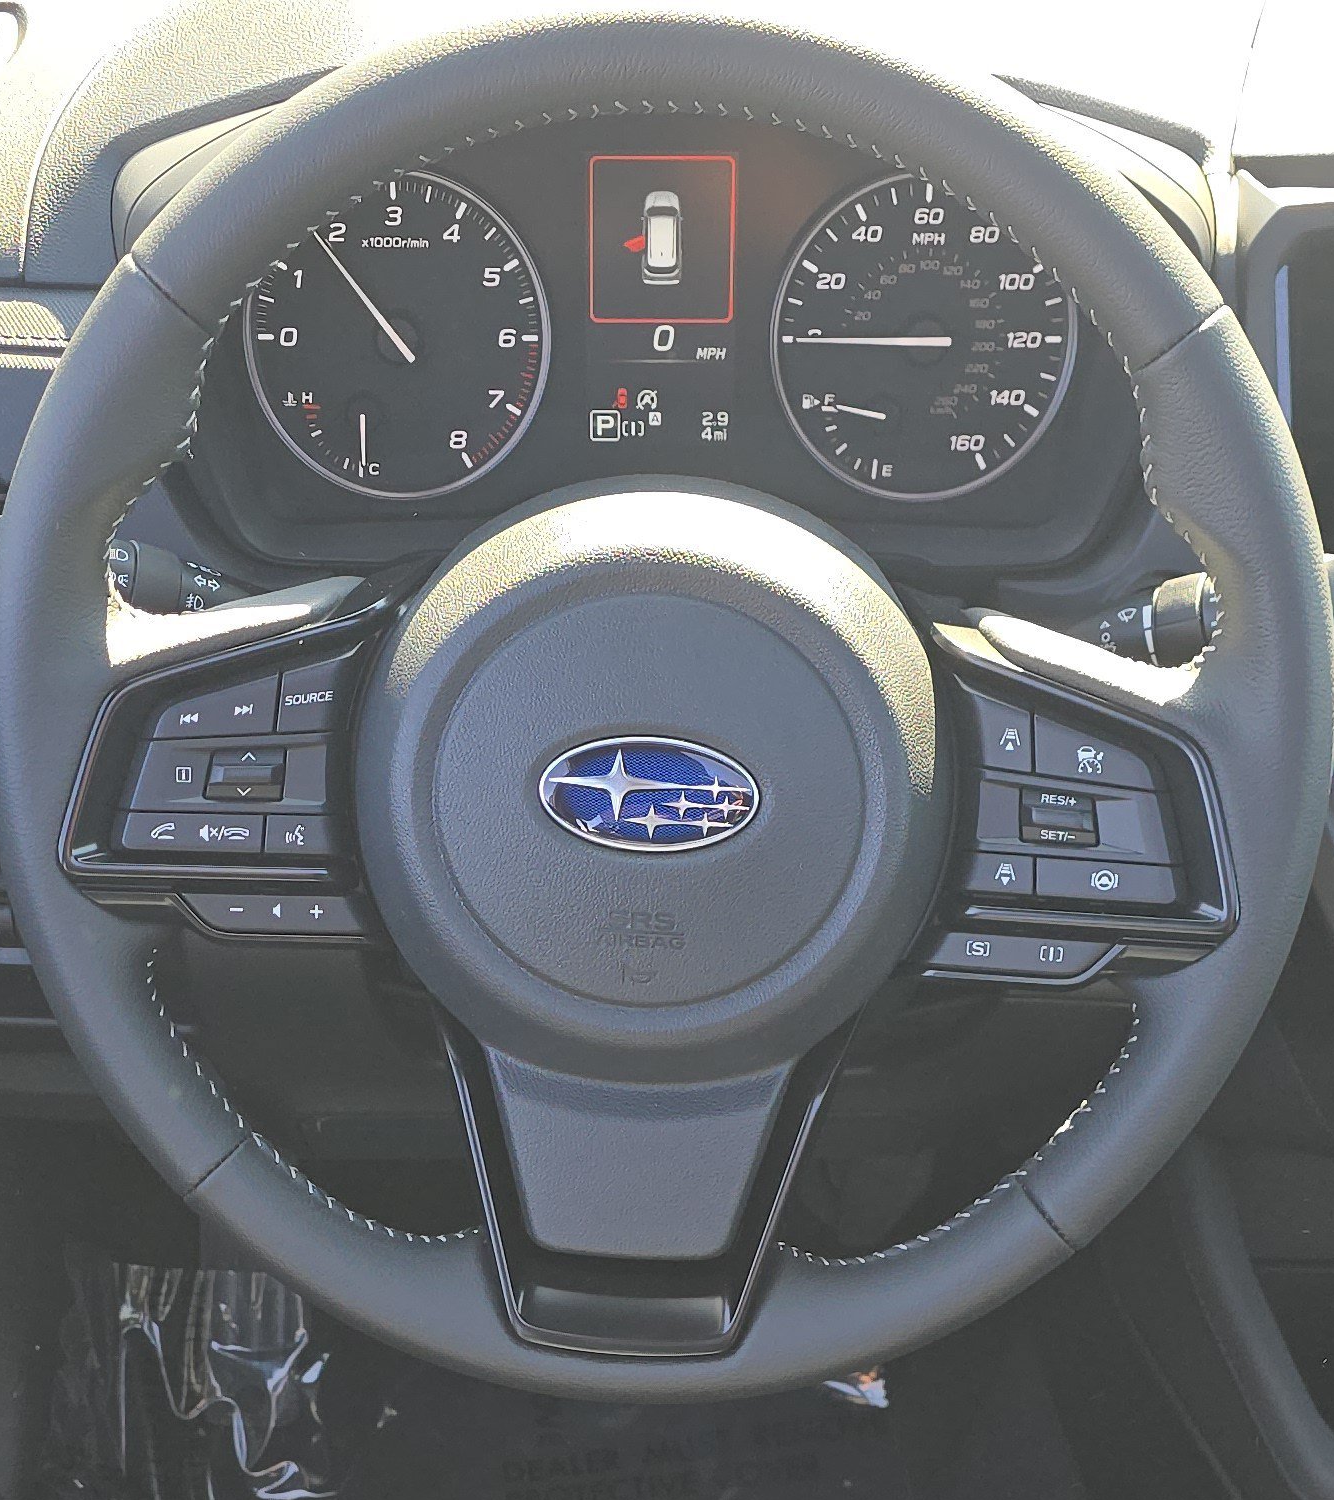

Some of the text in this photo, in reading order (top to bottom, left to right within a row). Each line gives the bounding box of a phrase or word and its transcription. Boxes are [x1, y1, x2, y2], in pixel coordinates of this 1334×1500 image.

[384, 206, 403, 226] 3
[914, 207, 945, 225] 60
[327, 222, 347, 242] 2
[442, 223, 461, 243] 4
[852, 225, 883, 243] 40
[912, 233, 946, 246] MPH
[969, 226, 1000, 244] 80
[293, 269, 303, 288] 1
[482, 267, 502, 287] 5
[816, 273, 846, 290] 20
[998, 273, 1035, 291] 100
[279, 327, 298, 347] 0
[497, 328, 517, 348] 6
[652, 324, 675, 352] 0
[1007, 331, 1042, 349] 120
[696, 347, 727, 360] MPH
[301, 392, 313, 404] H
[488, 389, 505, 409] 7
[824, 393, 836, 406] F
[989, 389, 1025, 407] 140
[596, 415, 615, 436] P
[449, 430, 468, 450] 8
[950, 434, 985, 451] 160
[368, 463, 380, 476] C
[881, 464, 893, 477] E
[284, 690, 334, 706] SOURCE
